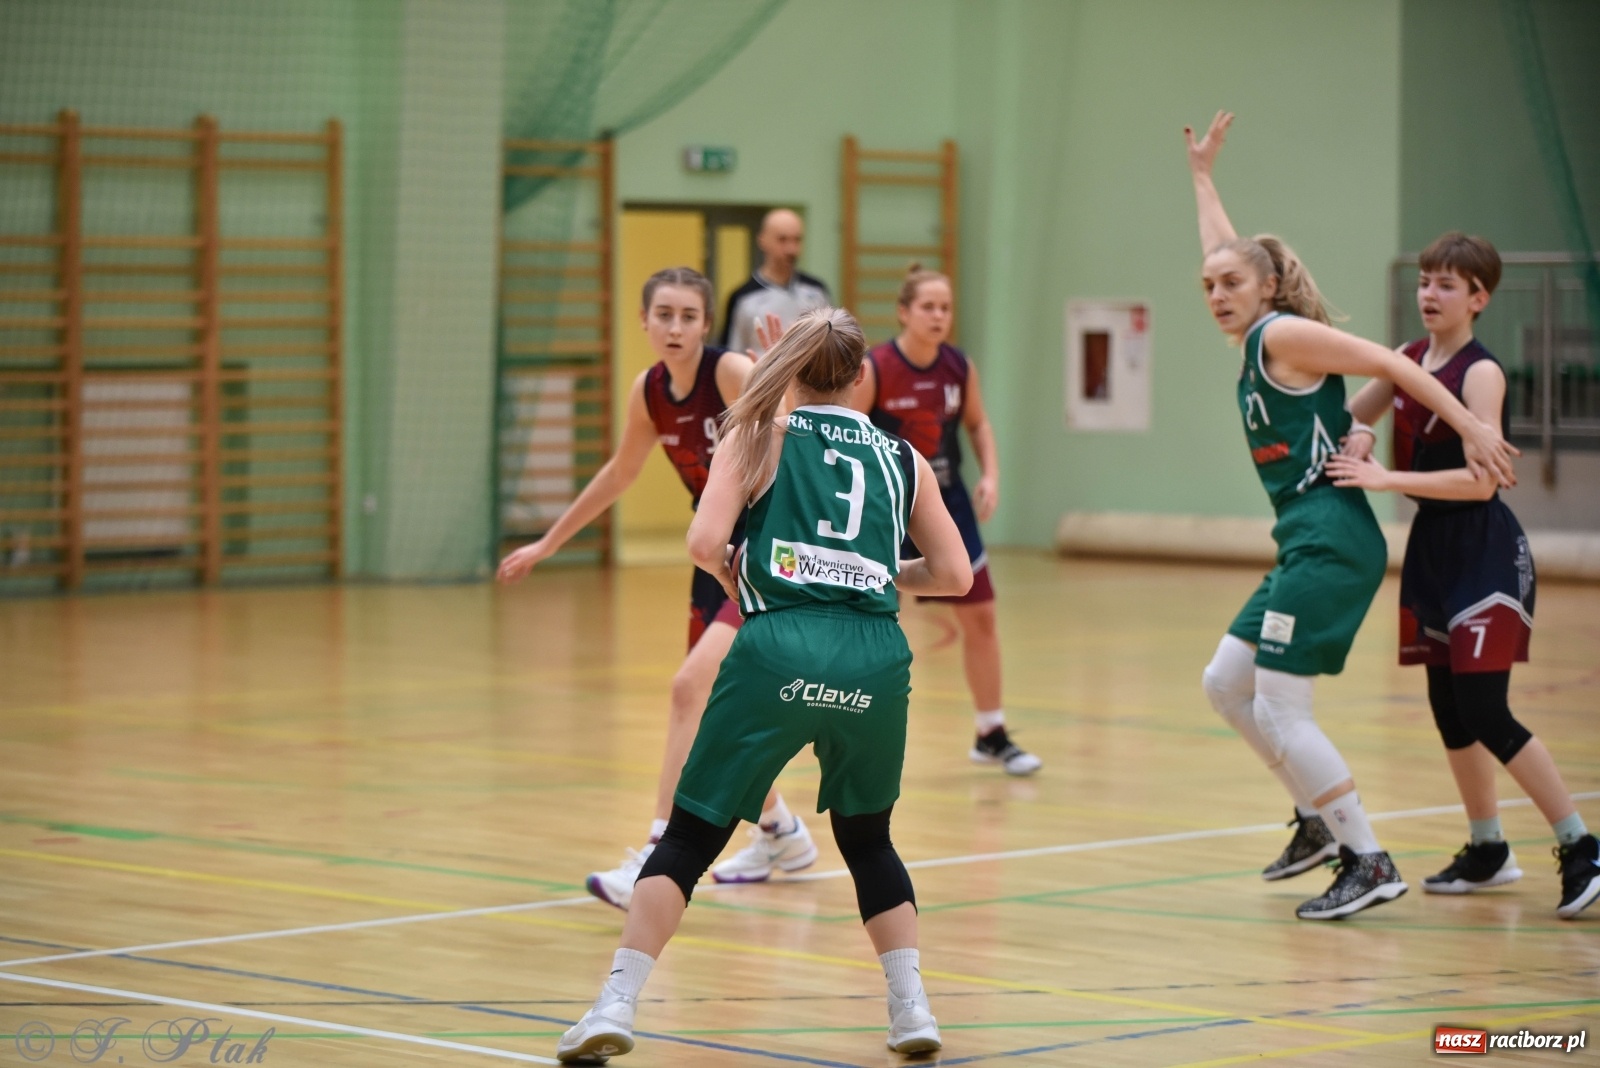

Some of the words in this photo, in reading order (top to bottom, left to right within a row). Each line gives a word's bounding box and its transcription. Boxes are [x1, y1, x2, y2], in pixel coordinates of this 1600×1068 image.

[816, 448, 865, 541] 3
[798, 554, 864, 574] wydawnictwo
[1469, 625, 1486, 659] 7
[802, 683, 873, 709] Clavis
